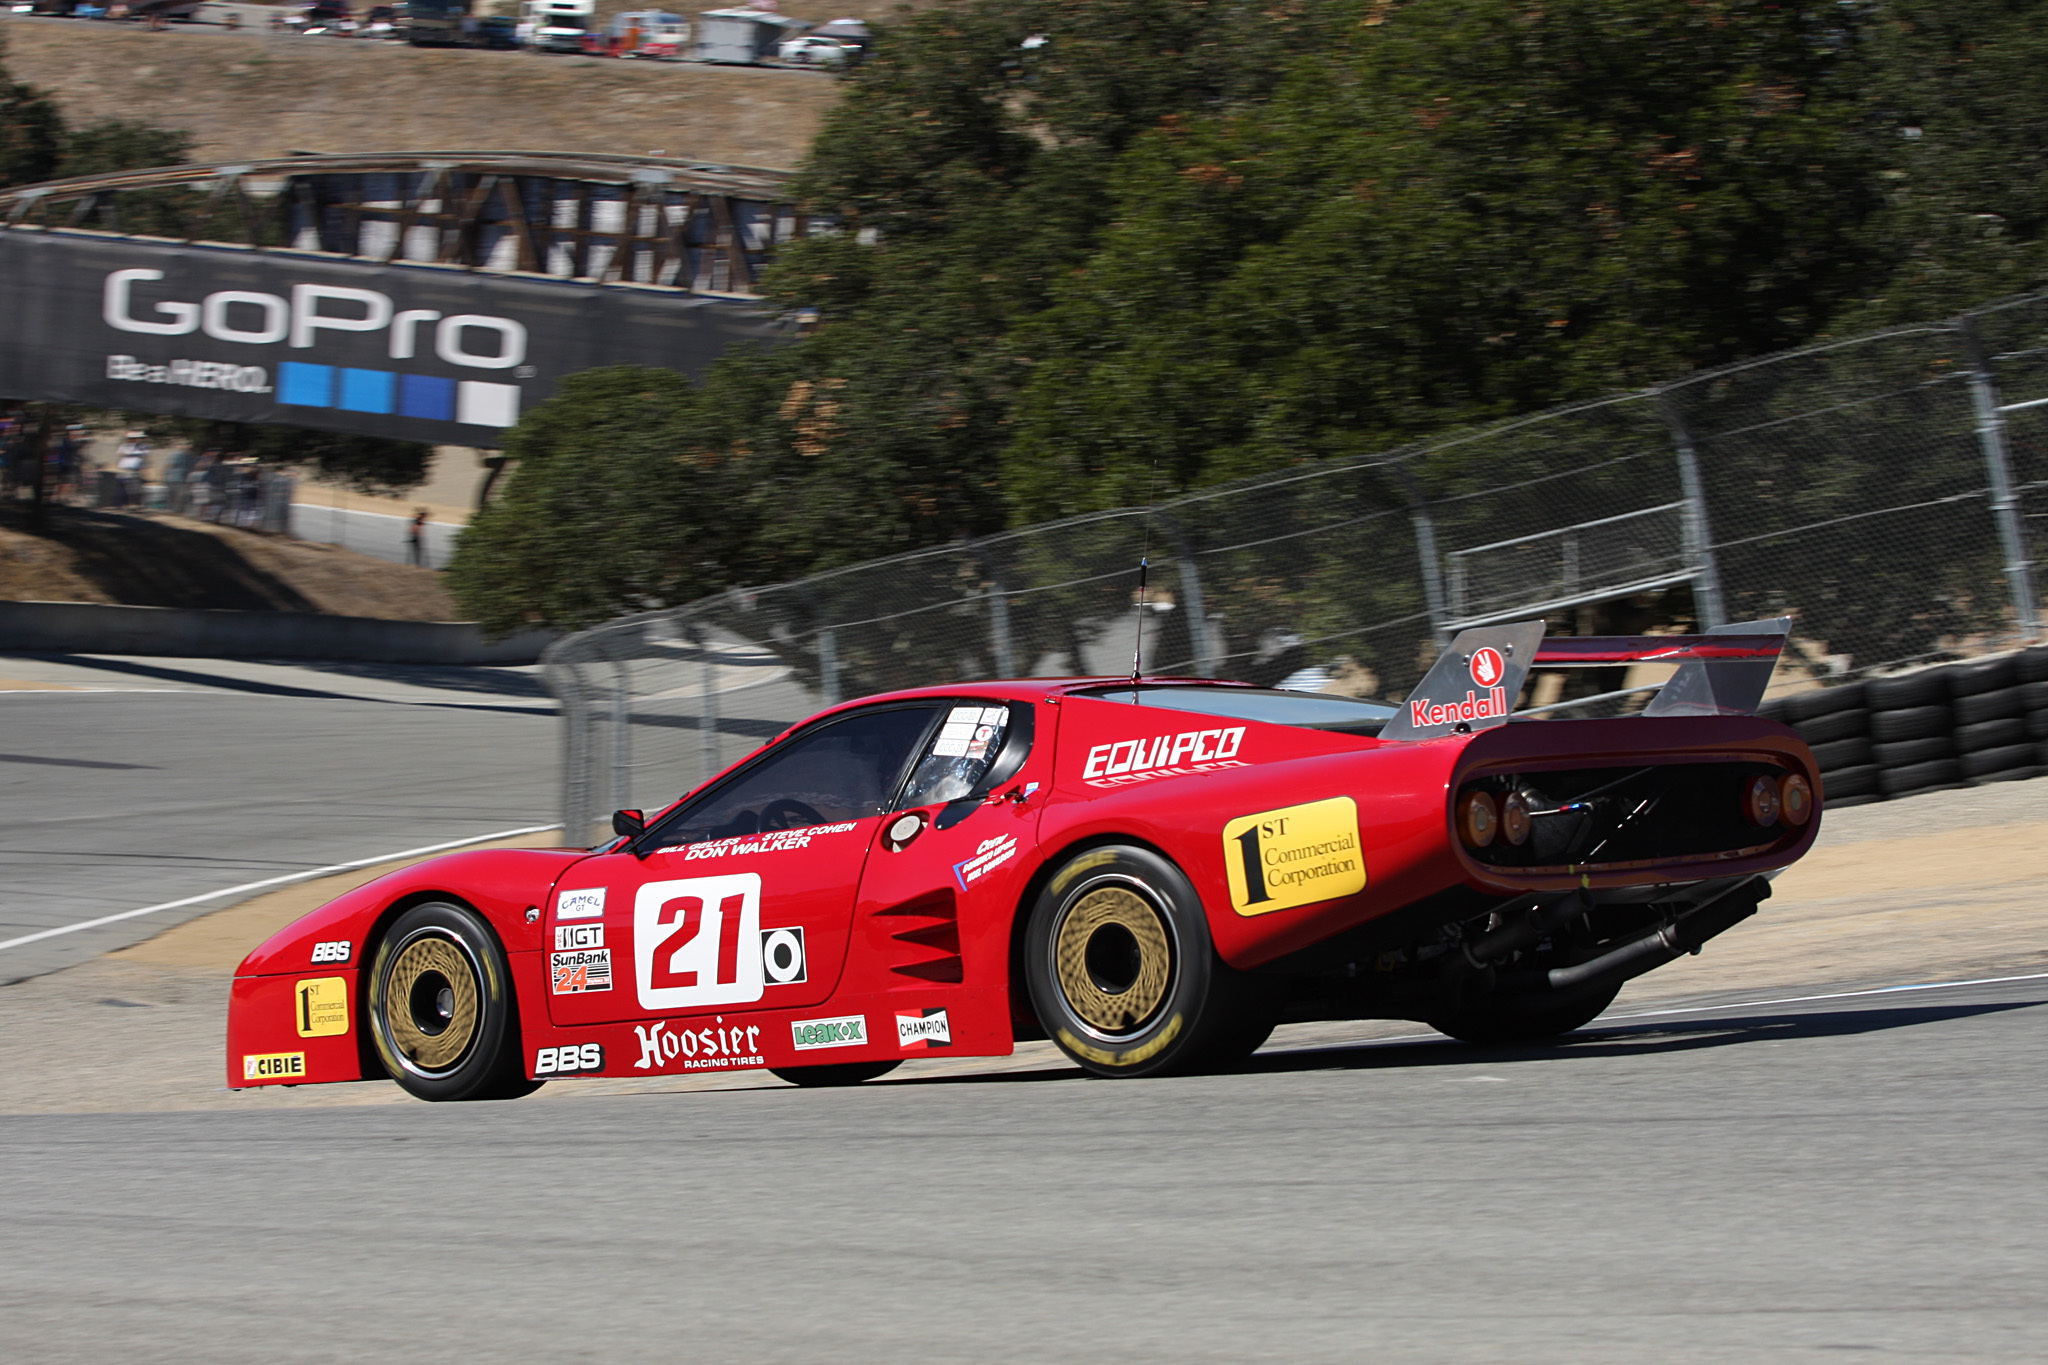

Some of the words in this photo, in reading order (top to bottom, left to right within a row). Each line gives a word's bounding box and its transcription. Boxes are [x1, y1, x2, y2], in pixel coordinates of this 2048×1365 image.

[103, 268, 528, 369] GoPro
[106, 354, 148, 381] Be
[1411, 686, 1507, 728] Kendall
[981, 729, 990, 738] T
[1082, 726, 1247, 779] EQUIPCO
[657, 845, 686, 854] BILL
[761, 828, 809, 841] STEVE
[807, 822, 858, 836] COHEN
[684, 845, 729, 861] DON
[730, 836, 812, 856] WALKER
[1264, 832, 1355, 866] Commercial
[1267, 857, 1356, 887] Corporation
[561, 895, 601, 910] CAMEL
[575, 904, 586, 912] GT
[575, 926, 602, 946] GT
[650, 892, 745, 990] 21
[311, 940, 351, 963] BBS
[552, 950, 609, 967] SunBank
[555, 965, 588, 992] 24
[310, 999, 345, 1012] Commercial
[310, 1012, 345, 1026] Corporation
[899, 1019, 948, 1037] CHAMPION
[633, 1015, 761, 1069] Hoosier
[535, 1042, 603, 1074] BBS
[684, 1058, 729, 1069] RACING
[729, 1055, 765, 1067] TIRES
